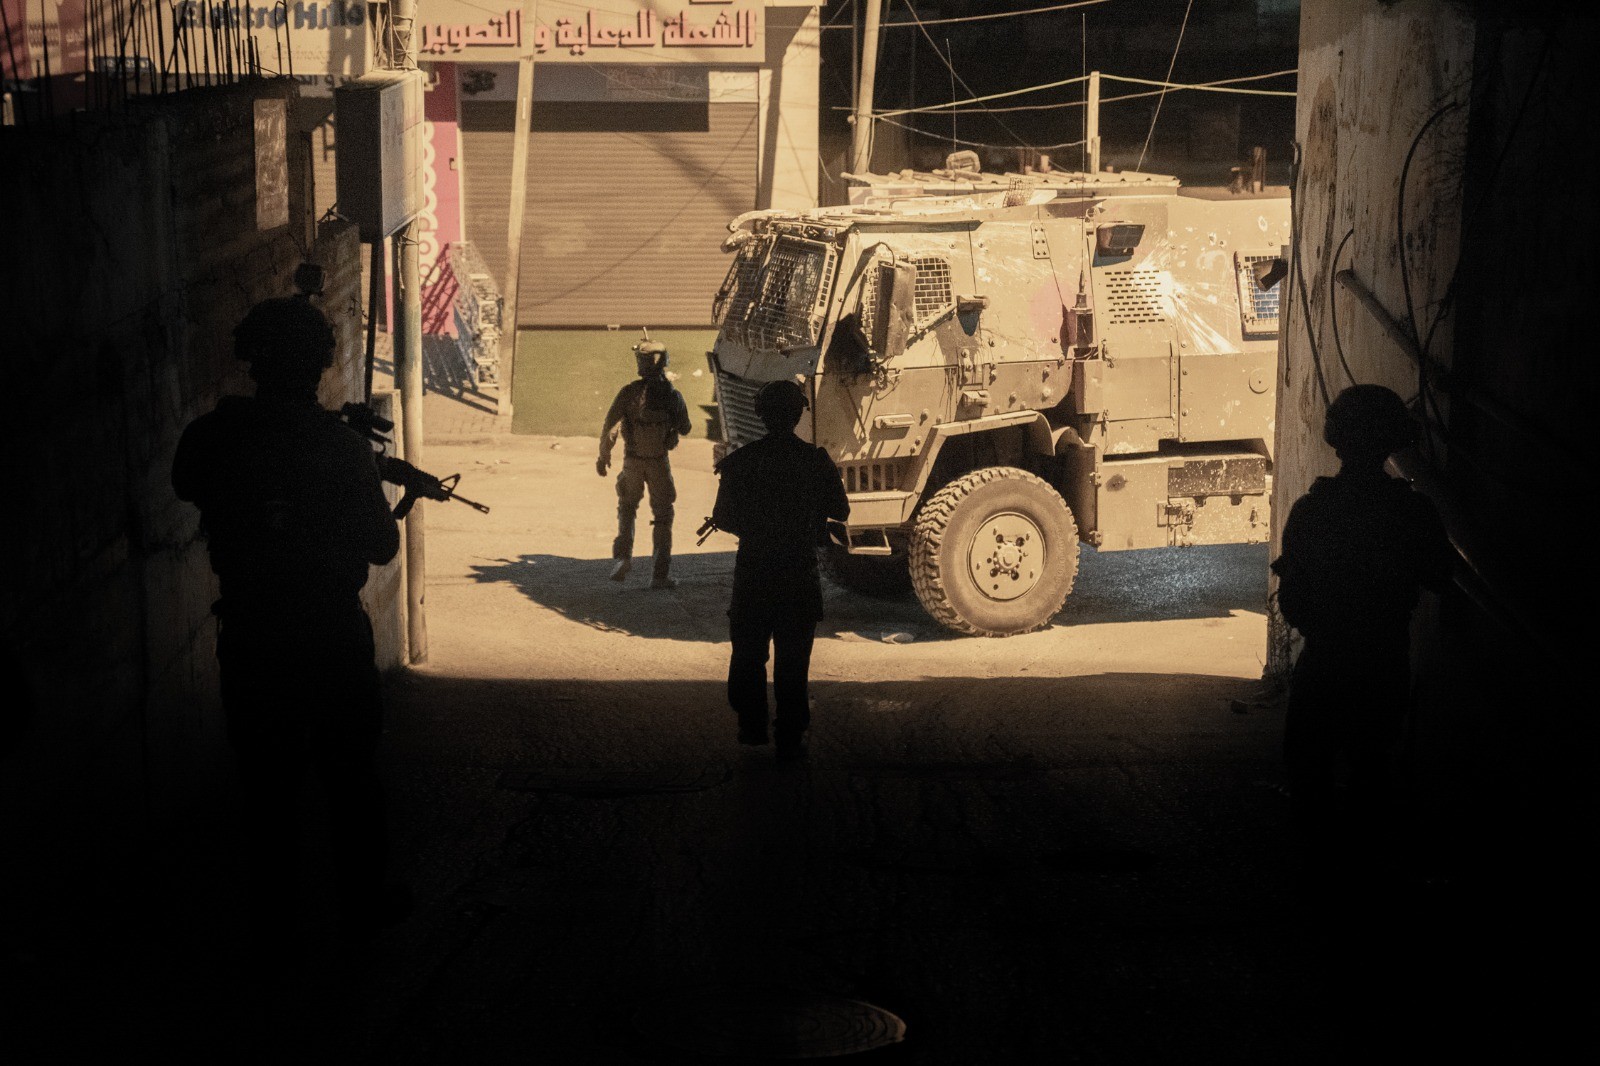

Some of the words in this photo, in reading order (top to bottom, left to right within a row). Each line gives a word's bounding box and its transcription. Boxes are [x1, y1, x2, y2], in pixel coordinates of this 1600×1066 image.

[419, 9, 522, 54] التصوير
[534, 25, 552, 55] و
[555, 9, 657, 56] للدعاية
[662, 9, 757, 48] الشعلة
